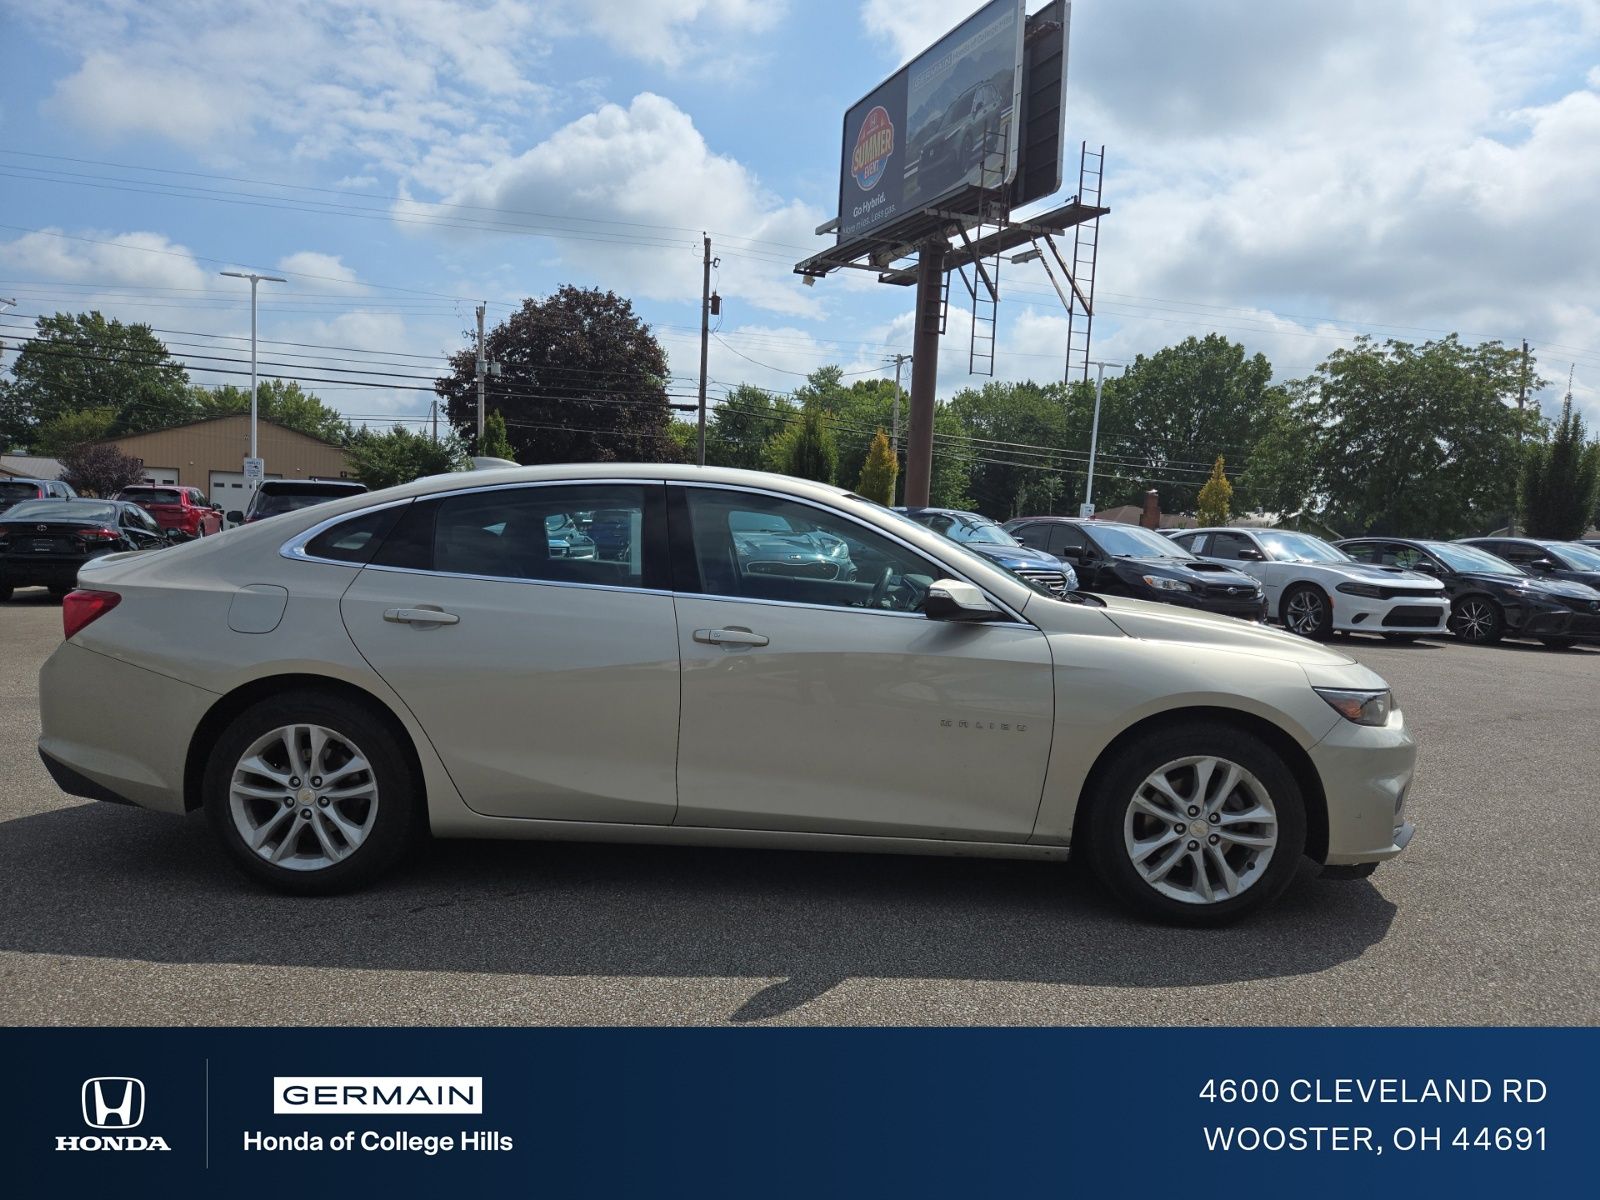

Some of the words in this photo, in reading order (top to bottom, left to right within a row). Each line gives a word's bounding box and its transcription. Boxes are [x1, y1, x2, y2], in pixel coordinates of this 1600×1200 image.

[854, 128, 892, 171] SUMMER
[853, 206, 863, 218] Go
[862, 191, 886, 214] Hybrid.
[940, 719, 1027, 732] MALIBU
